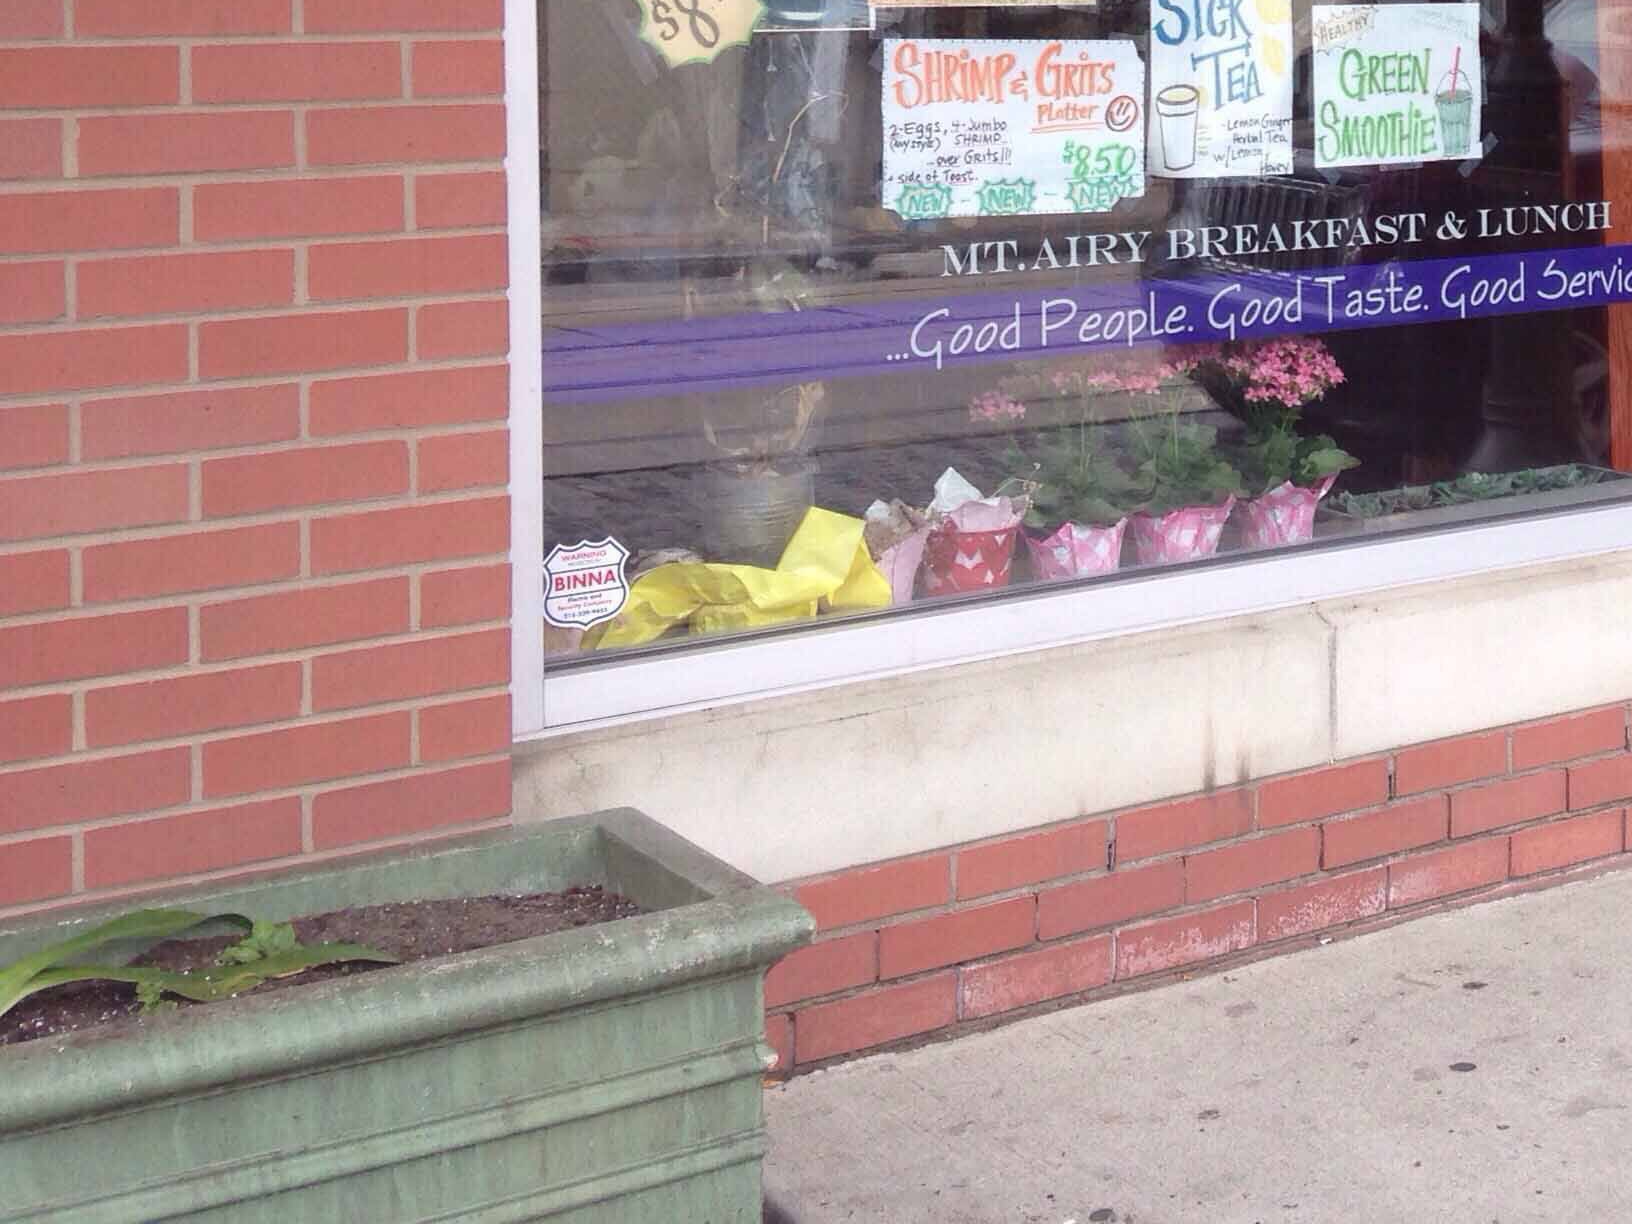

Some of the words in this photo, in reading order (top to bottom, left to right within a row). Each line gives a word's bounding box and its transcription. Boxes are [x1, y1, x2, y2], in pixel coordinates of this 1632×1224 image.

[1191, 40, 1265, 112] TEA
[1339, 47, 1432, 102] GREEN
[908, 192, 942, 212] NEW
[987, 188, 1026, 209] NEW
[1080, 185, 1125, 205] NEW
[926, 169, 940, 182] of
[939, 230, 1153, 279] MT.AIRY
[1166, 212, 1427, 262] BREAKFAST
[1436, 210, 1469, 242] &
[1477, 201, 1612, 239] LUNCH
[1041, 291, 1195, 348] People.
[1208, 279, 1304, 342] Good
[1313, 273, 1430, 325] Taste.
[1440, 260, 1527, 320] Good
[555, 569, 617, 592] BINNA
